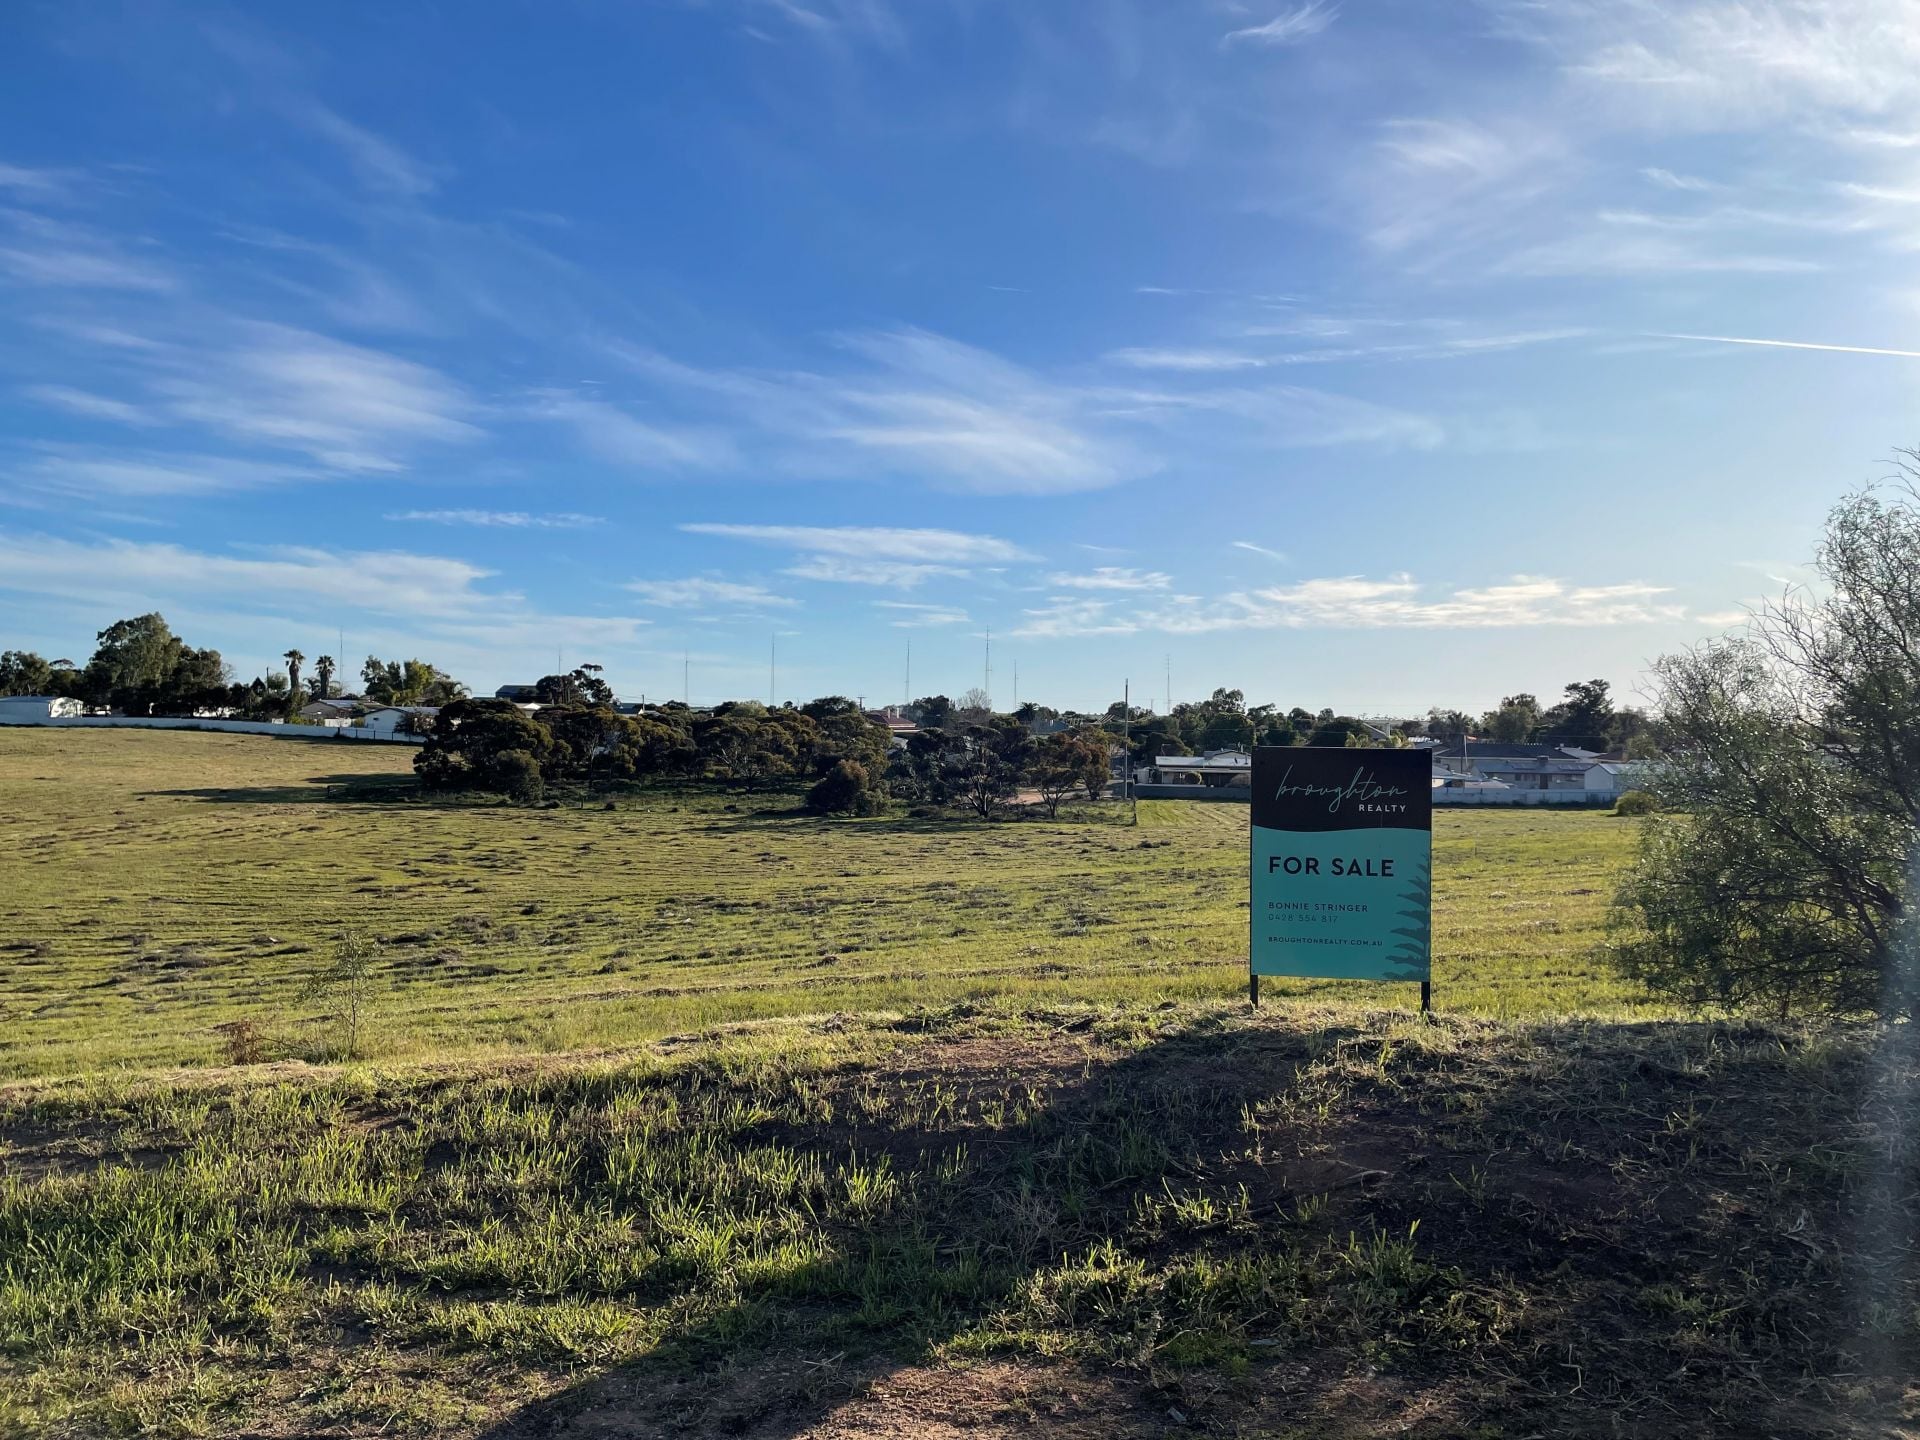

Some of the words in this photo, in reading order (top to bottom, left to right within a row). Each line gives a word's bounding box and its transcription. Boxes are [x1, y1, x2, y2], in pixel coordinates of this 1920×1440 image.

[1275, 764, 1408, 813] broughton
[1358, 804, 1407, 813] REALTY
[1269, 856, 1320, 875] FOR
[1331, 858, 1394, 877] SALE
[1268, 901, 1310, 911] BONNIE
[1315, 903, 1368, 913] STRINGER
[1321, 914, 1338, 923] 817
[1268, 936, 1383, 947] BROUGHTONREALTY.COM.AU
